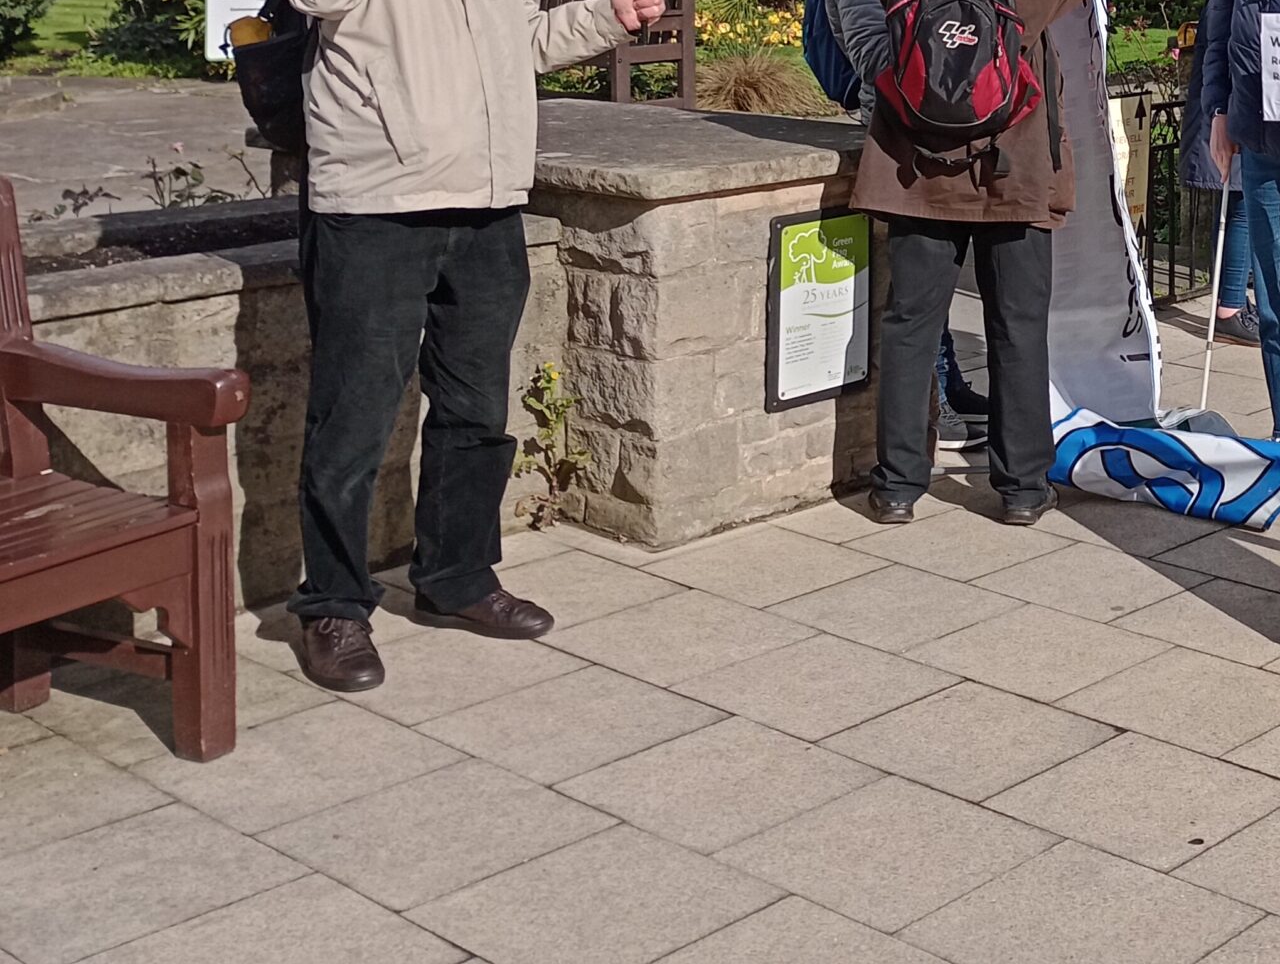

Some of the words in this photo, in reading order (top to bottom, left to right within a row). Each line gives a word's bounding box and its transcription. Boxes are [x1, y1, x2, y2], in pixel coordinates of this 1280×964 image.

[832, 236, 854, 247] Green
[802, 288, 817, 305] 25
[820, 286, 849, 301] YEARS
